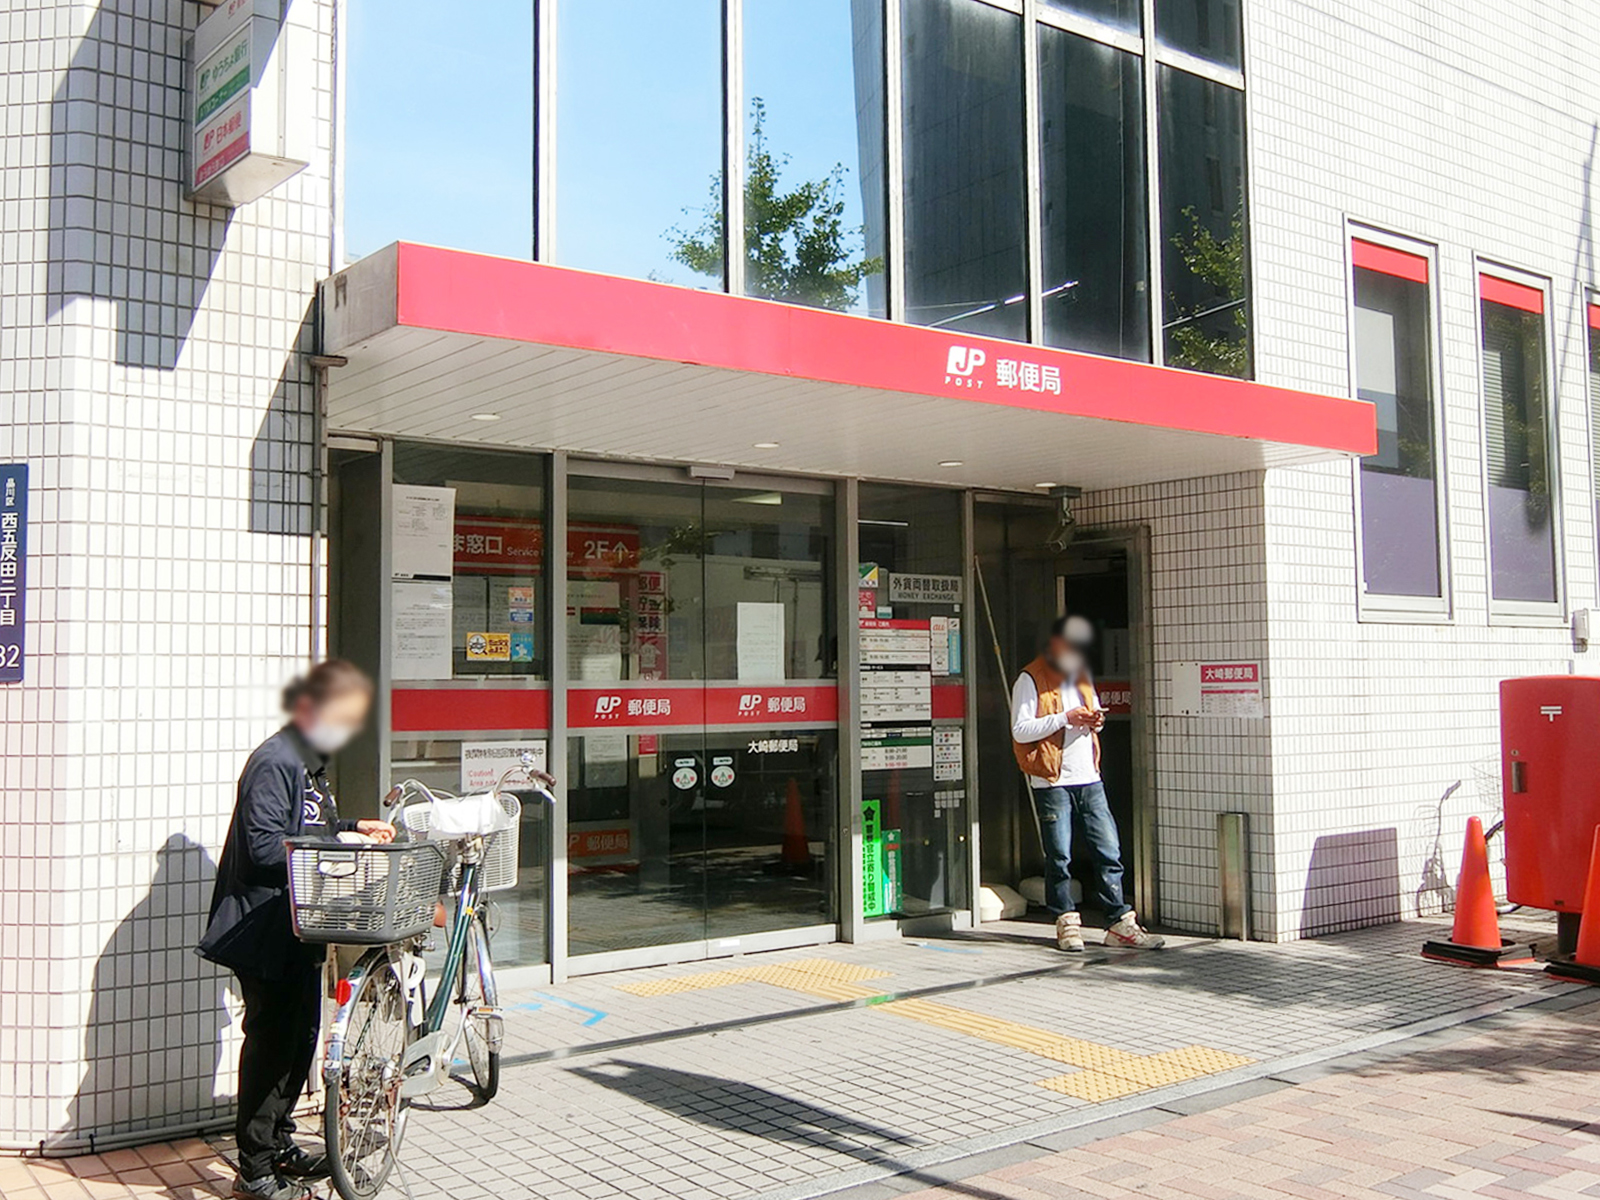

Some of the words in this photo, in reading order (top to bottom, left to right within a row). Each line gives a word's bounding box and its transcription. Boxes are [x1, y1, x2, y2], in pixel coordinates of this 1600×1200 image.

[216, 110, 242, 145] 日本郵便
[945, 376, 984, 389] POST
[996, 359, 1061, 395] 郵便局
[5, 476, 16, 507] 品川区
[507, 546, 540, 557] Service
[585, 540, 609, 559] 2F
[0, 512, 18, 627] 西五反田二丁目
[893, 577, 959, 593] 外貨両替取扱局
[898, 592, 919, 600] MONEY
[923, 593, 955, 601] EXCHANGE
[1205, 667, 1254, 680] 大崎郵便局
[627, 699, 672, 717] 郵便局
[767, 696, 806, 714] 郵便局
[748, 738, 798, 754] 大崎郵便局
[587, 833, 628, 851] 郵便局
